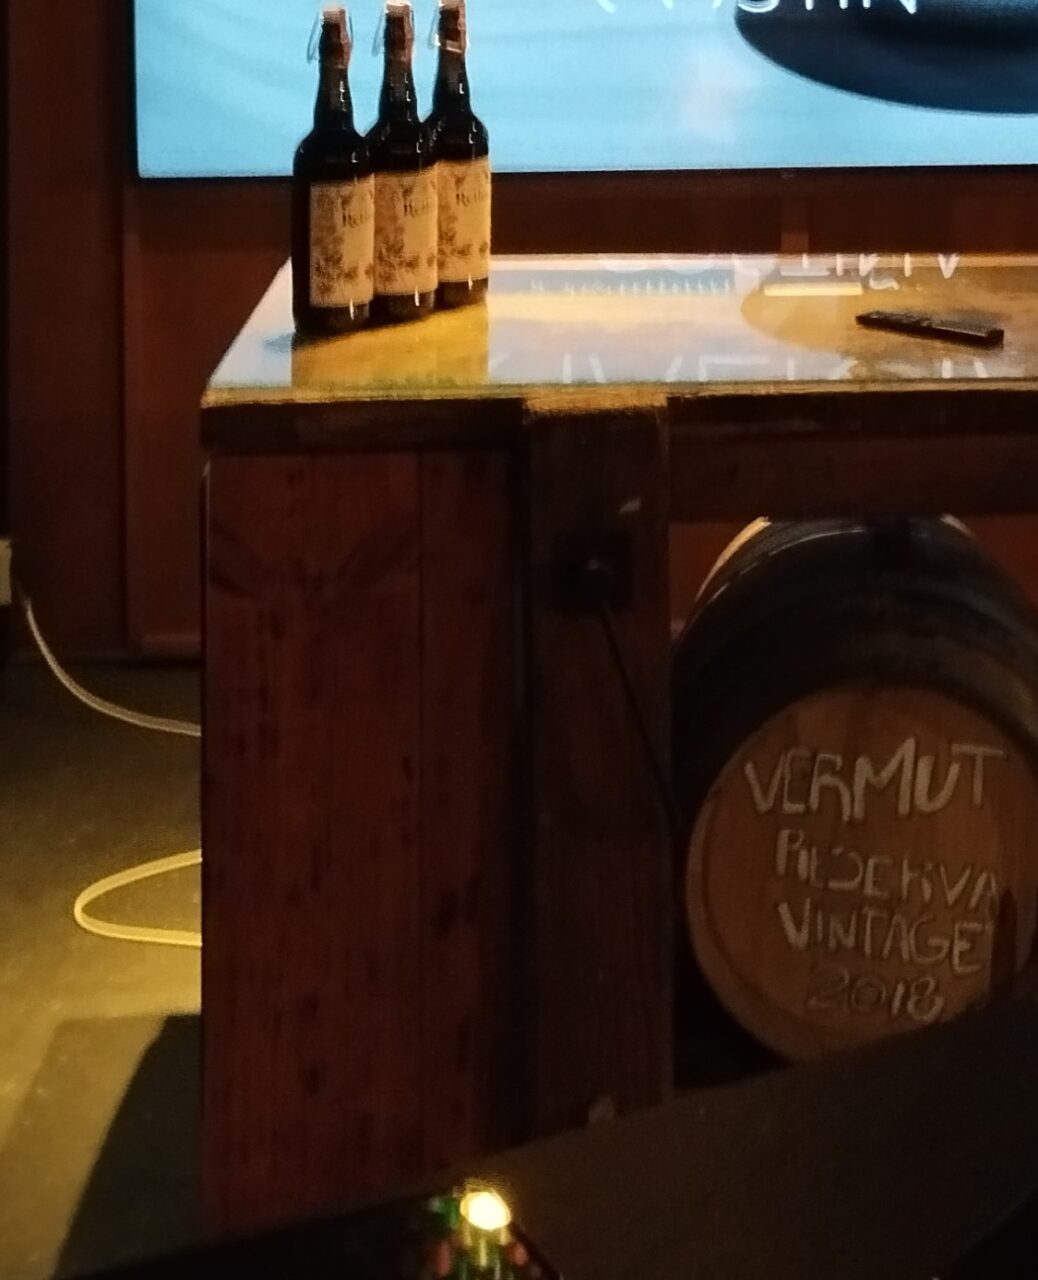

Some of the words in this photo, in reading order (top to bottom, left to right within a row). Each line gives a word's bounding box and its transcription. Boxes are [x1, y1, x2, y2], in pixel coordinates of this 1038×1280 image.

[745, 736, 1003, 824] VERMUT
[776, 896, 985, 975] VINTAGE
[806, 964, 944, 1022] 2018
